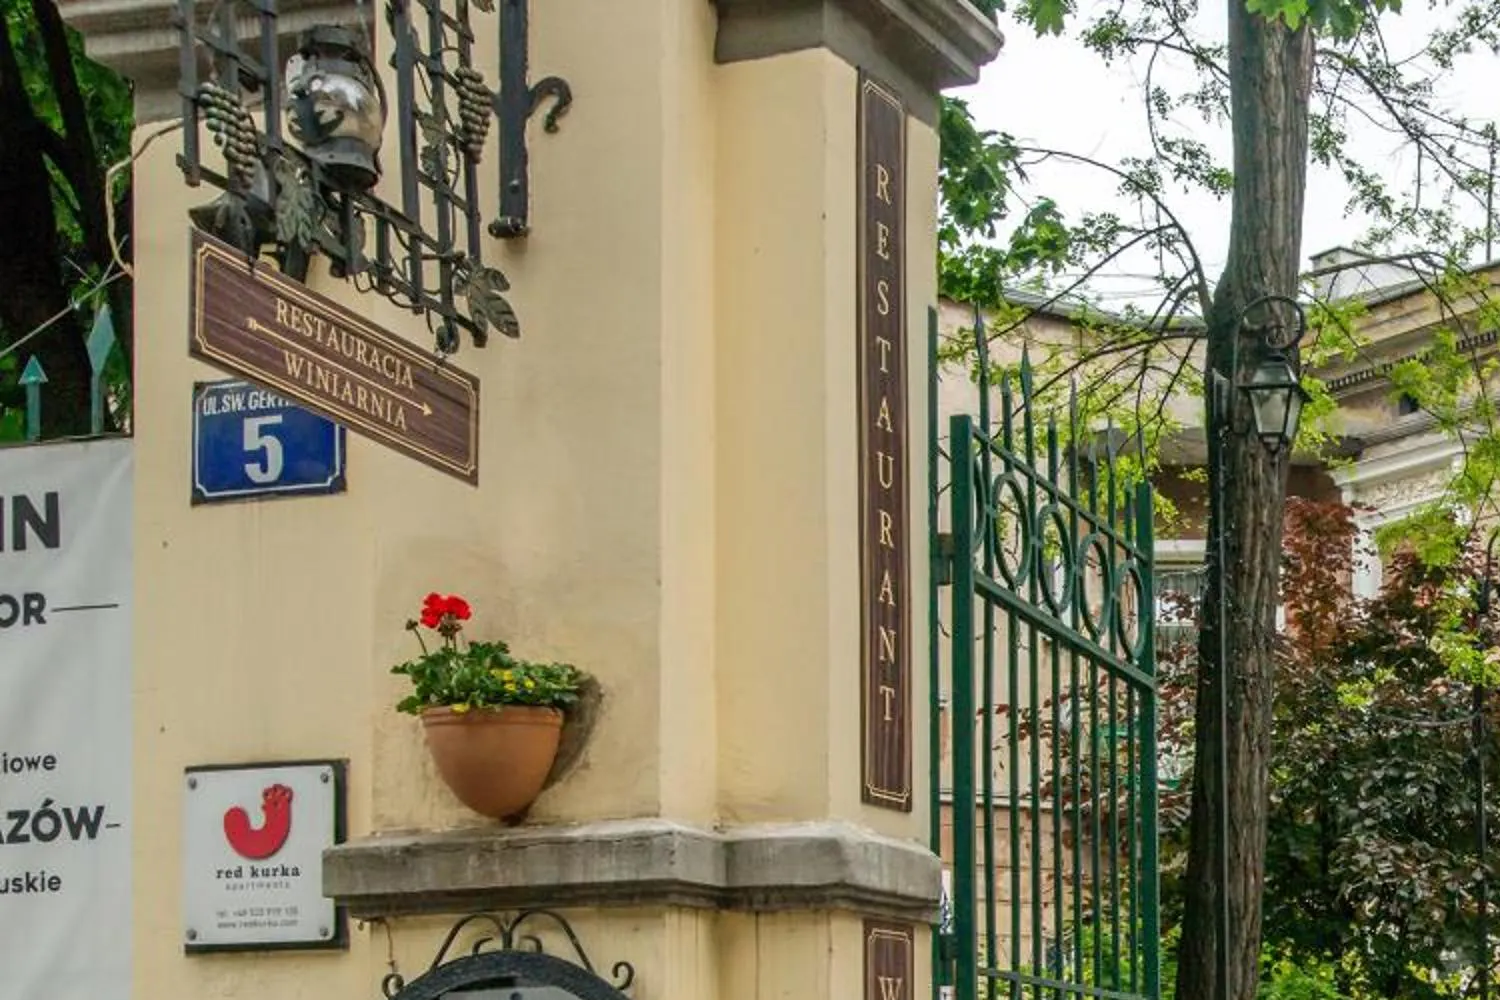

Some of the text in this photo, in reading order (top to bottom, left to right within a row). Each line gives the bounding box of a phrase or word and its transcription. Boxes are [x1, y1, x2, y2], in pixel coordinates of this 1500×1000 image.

[275, 297, 414, 389] RESTAURACJA
[283, 350, 408, 432] WINIARNIA
[243, 414, 283, 484] 5
[876, 163, 895, 721] RESTAURANT
[0, 752, 57, 774] iowe
[0, 797, 105, 844] ZÓW
[216, 864, 301, 879] red kurka
